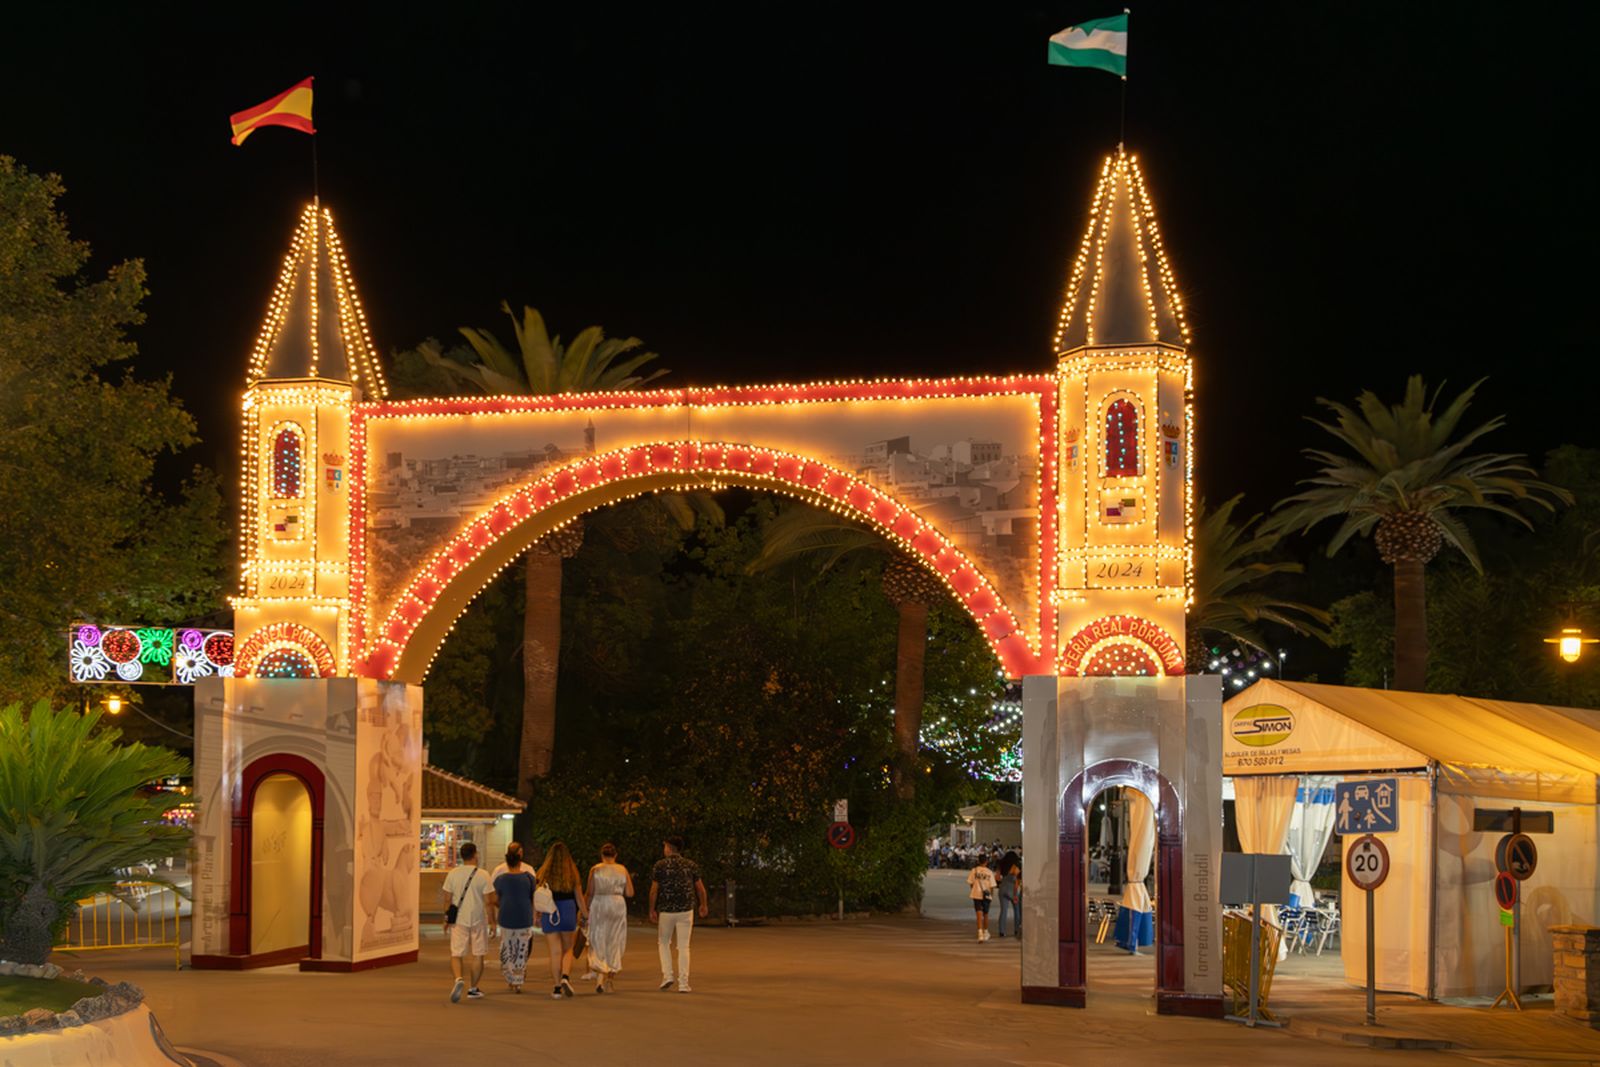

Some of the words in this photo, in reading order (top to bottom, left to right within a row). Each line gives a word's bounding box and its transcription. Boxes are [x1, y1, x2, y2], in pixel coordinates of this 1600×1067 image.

[1096, 561, 1144, 579] 2024
[269, 575, 308, 590] 2024
[238, 640, 262, 671] FERIA
[262, 626, 289, 644] REAL
[291, 628, 332, 671] PORCUNA
[1063, 637, 1093, 670] FERIA
[1092, 620, 1126, 639] REAL
[1129, 622, 1179, 670] PORCUNA
[1253, 717, 1292, 733] SIMON
[1355, 854, 1379, 872] 20
[1193, 853, 1209, 902] Boabdil
[1193, 906, 1209, 922] de
[1193, 926, 1209, 979] Torreón
